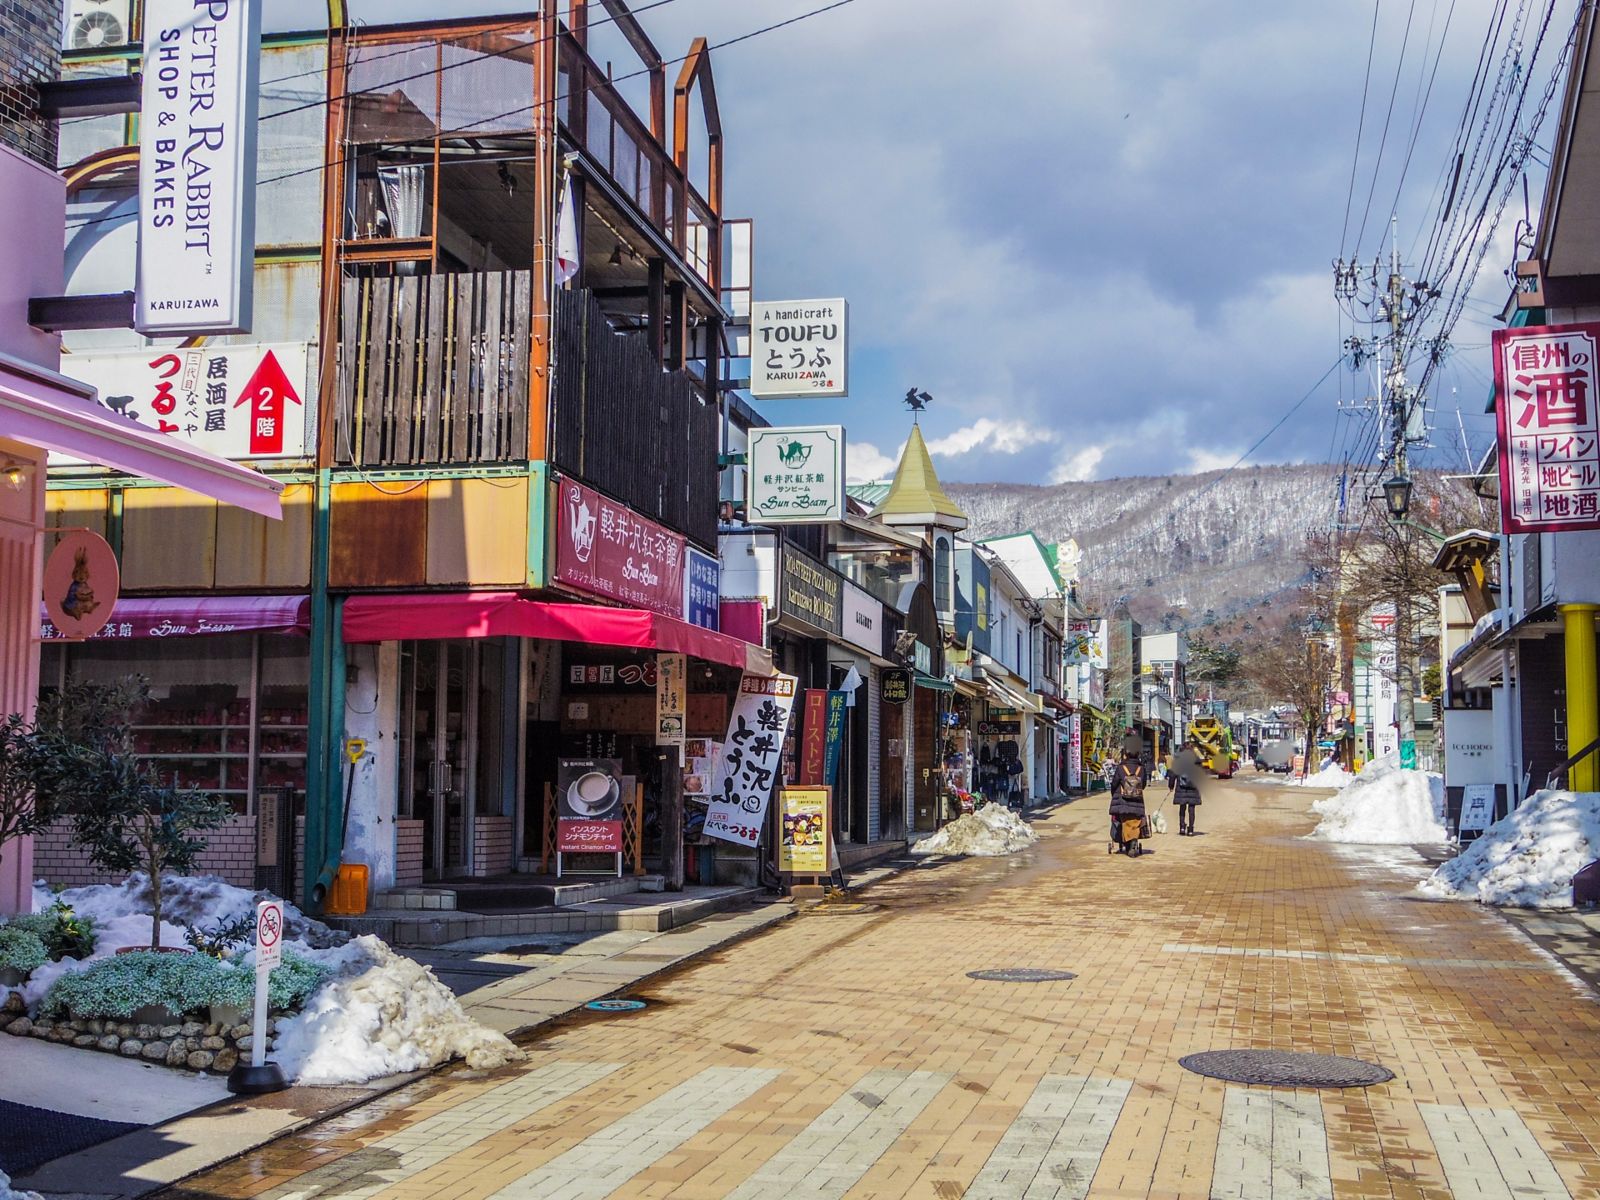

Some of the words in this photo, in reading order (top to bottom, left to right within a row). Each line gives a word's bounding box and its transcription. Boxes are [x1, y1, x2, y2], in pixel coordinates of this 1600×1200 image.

[158, 28, 180, 99] SHOP
[189, 0, 228, 117] PETER
[158, 111, 176, 127] &
[153, 139, 176, 228] BAKES
[182, 122, 224, 256] RABBIT
[150, 299, 219, 310] KARUIZAWA
[764, 310, 770, 320] A
[776, 308, 833, 320] handicraft
[759, 324, 838, 343] TOUFU
[766, 347, 832, 369] とうふ
[1512, 341, 1589, 370] 信州の
[767, 371, 827, 381] KARUIZAWA
[205, 356, 228, 432] 居酒屋
[1513, 368, 1589, 429] 酒
[256, 387, 275, 437] 2階
[1541, 436, 1595, 460] ワイン
[764, 474, 825, 484] 軽井沢紅茶館
[1542, 464, 1597, 488] 地ビール
[761, 495, 789, 509] Sun
[792, 493, 828, 508] Beam
[1544, 491, 1598, 517] 地酒
[600, 505, 678, 568] 軽井沢紅茶館
[742, 700, 788, 791] 軽井沢
[712, 714, 755, 804] とうふ
[565, 833, 614, 841] シナモンチャイ
